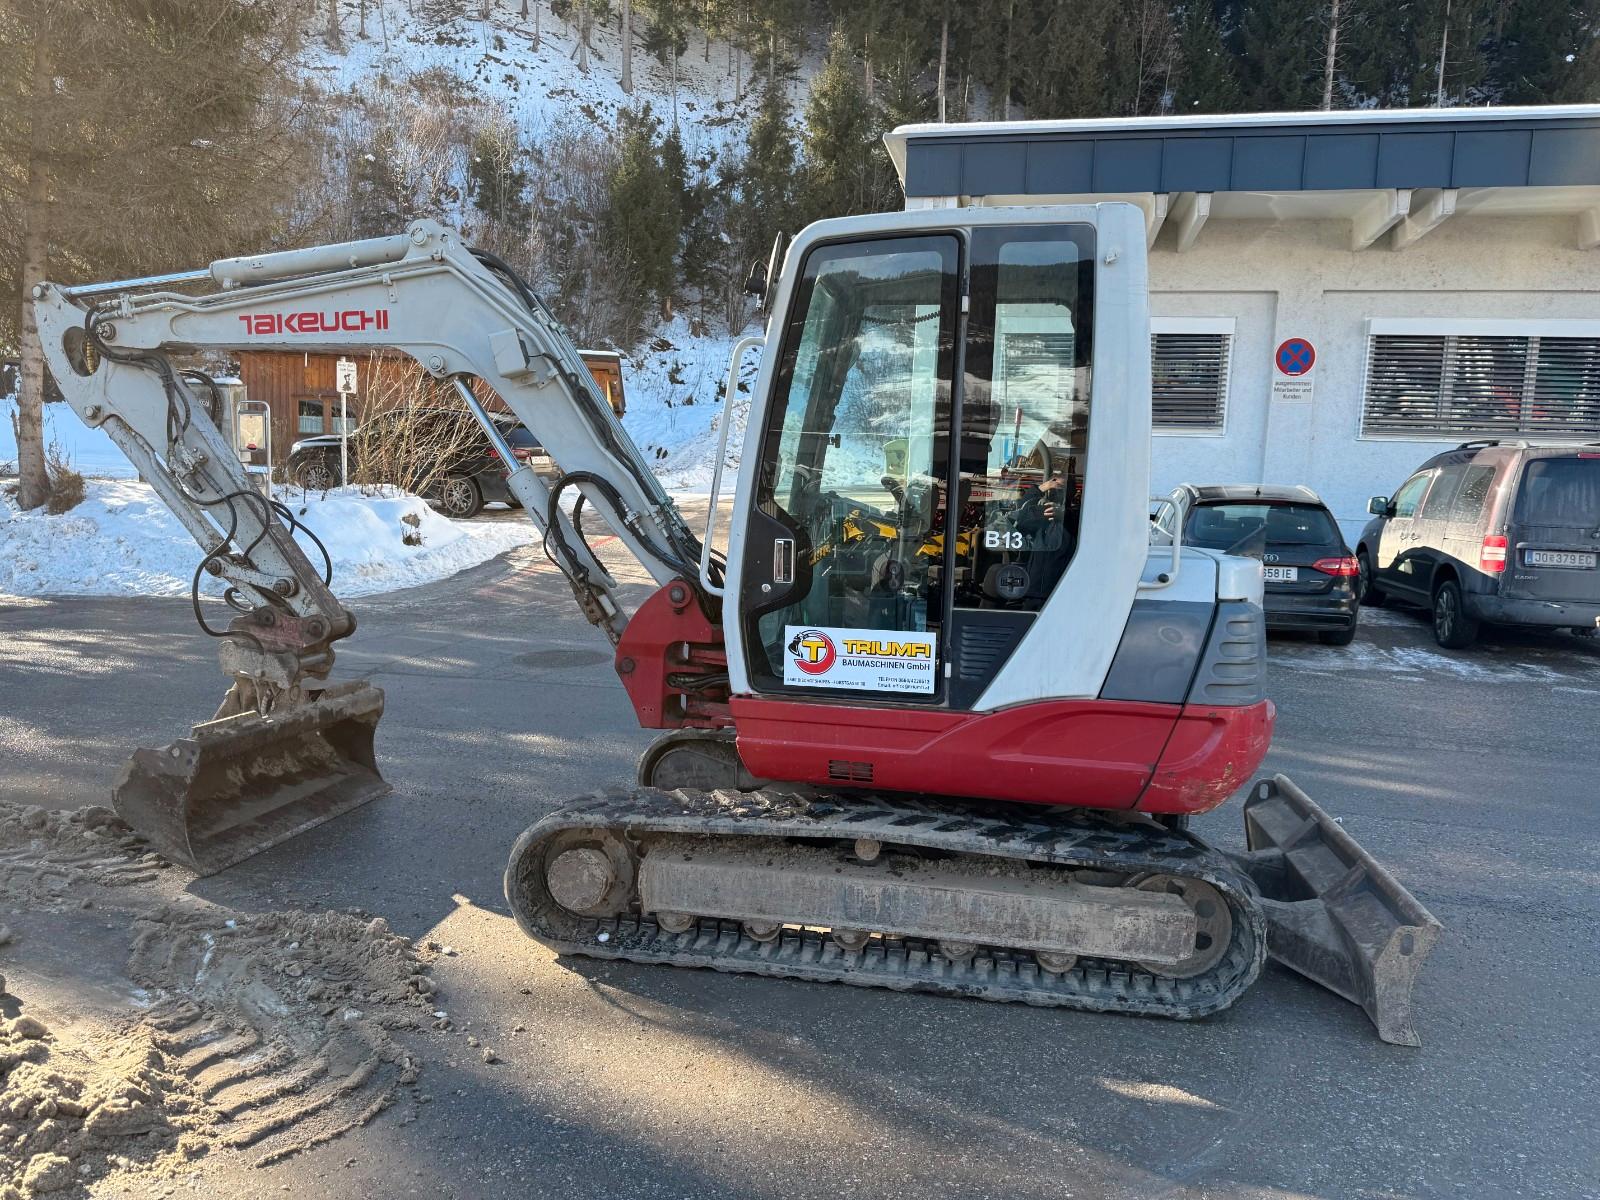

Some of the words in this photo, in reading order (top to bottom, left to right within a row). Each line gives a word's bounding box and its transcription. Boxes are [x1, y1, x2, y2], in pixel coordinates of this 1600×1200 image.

[985, 530, 1023, 549] B13
[842, 639, 931, 658] TRIUMFI
[842, 658, 905, 670] BAUMASCHINEN
[906, 661, 931, 671] GmbH
